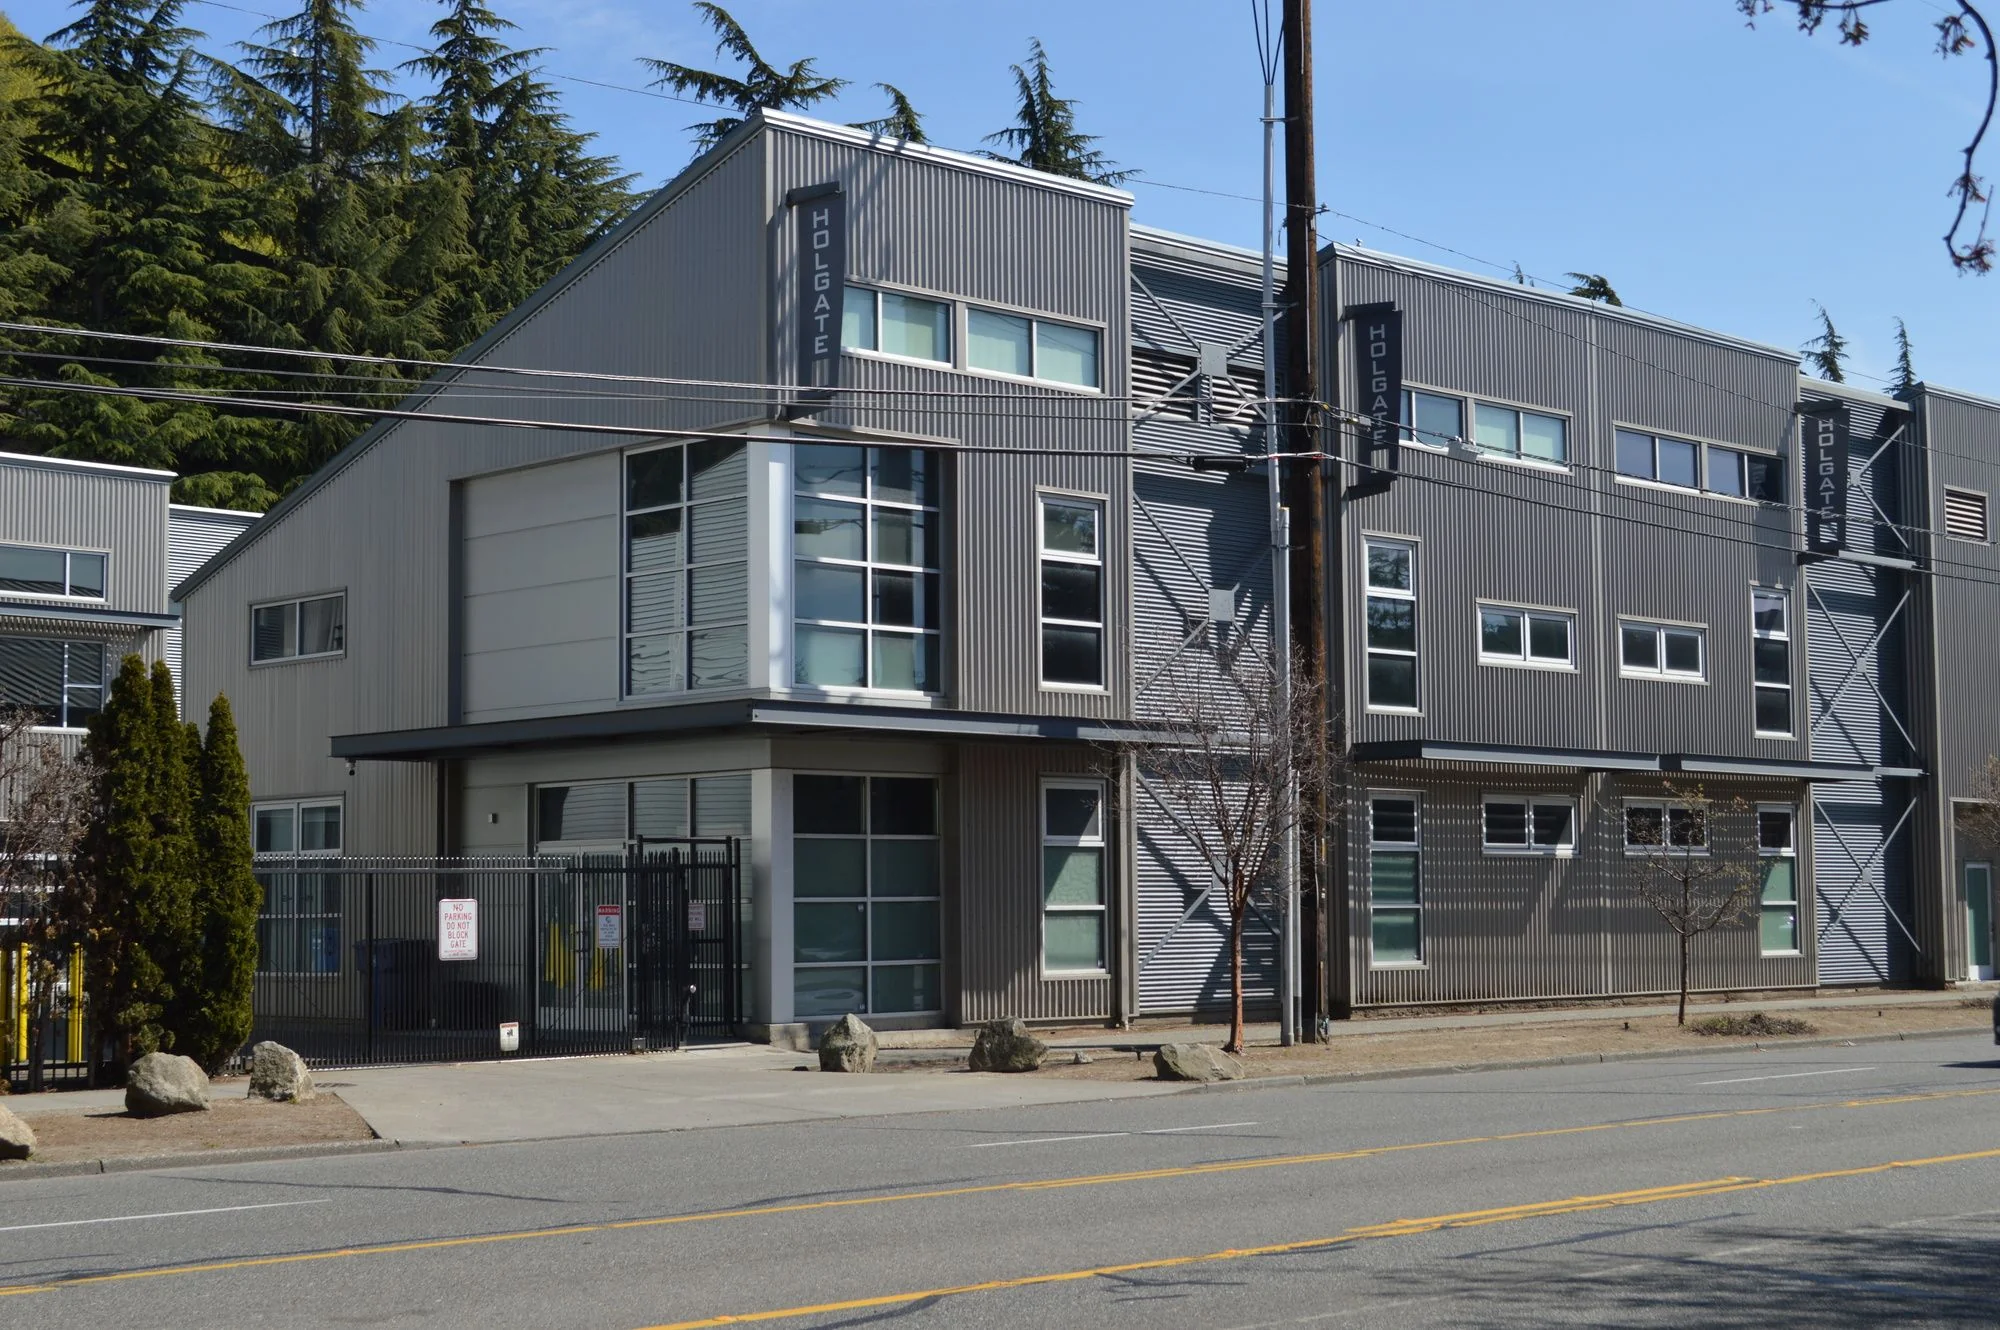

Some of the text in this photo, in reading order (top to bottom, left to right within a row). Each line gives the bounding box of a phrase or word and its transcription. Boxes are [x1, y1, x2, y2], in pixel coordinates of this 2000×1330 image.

[812, 208, 830, 355] HOLGATE
[1369, 323, 1388, 446] HOLGATE
[1818, 418, 1835, 519] HOLGATE
[453, 903, 464, 911] NO
[444, 912, 472, 921] PARKING
[446, 922, 470, 930] DO NOT
[447, 931, 469, 939] BLOCK
[450, 939, 466, 948] GATE
